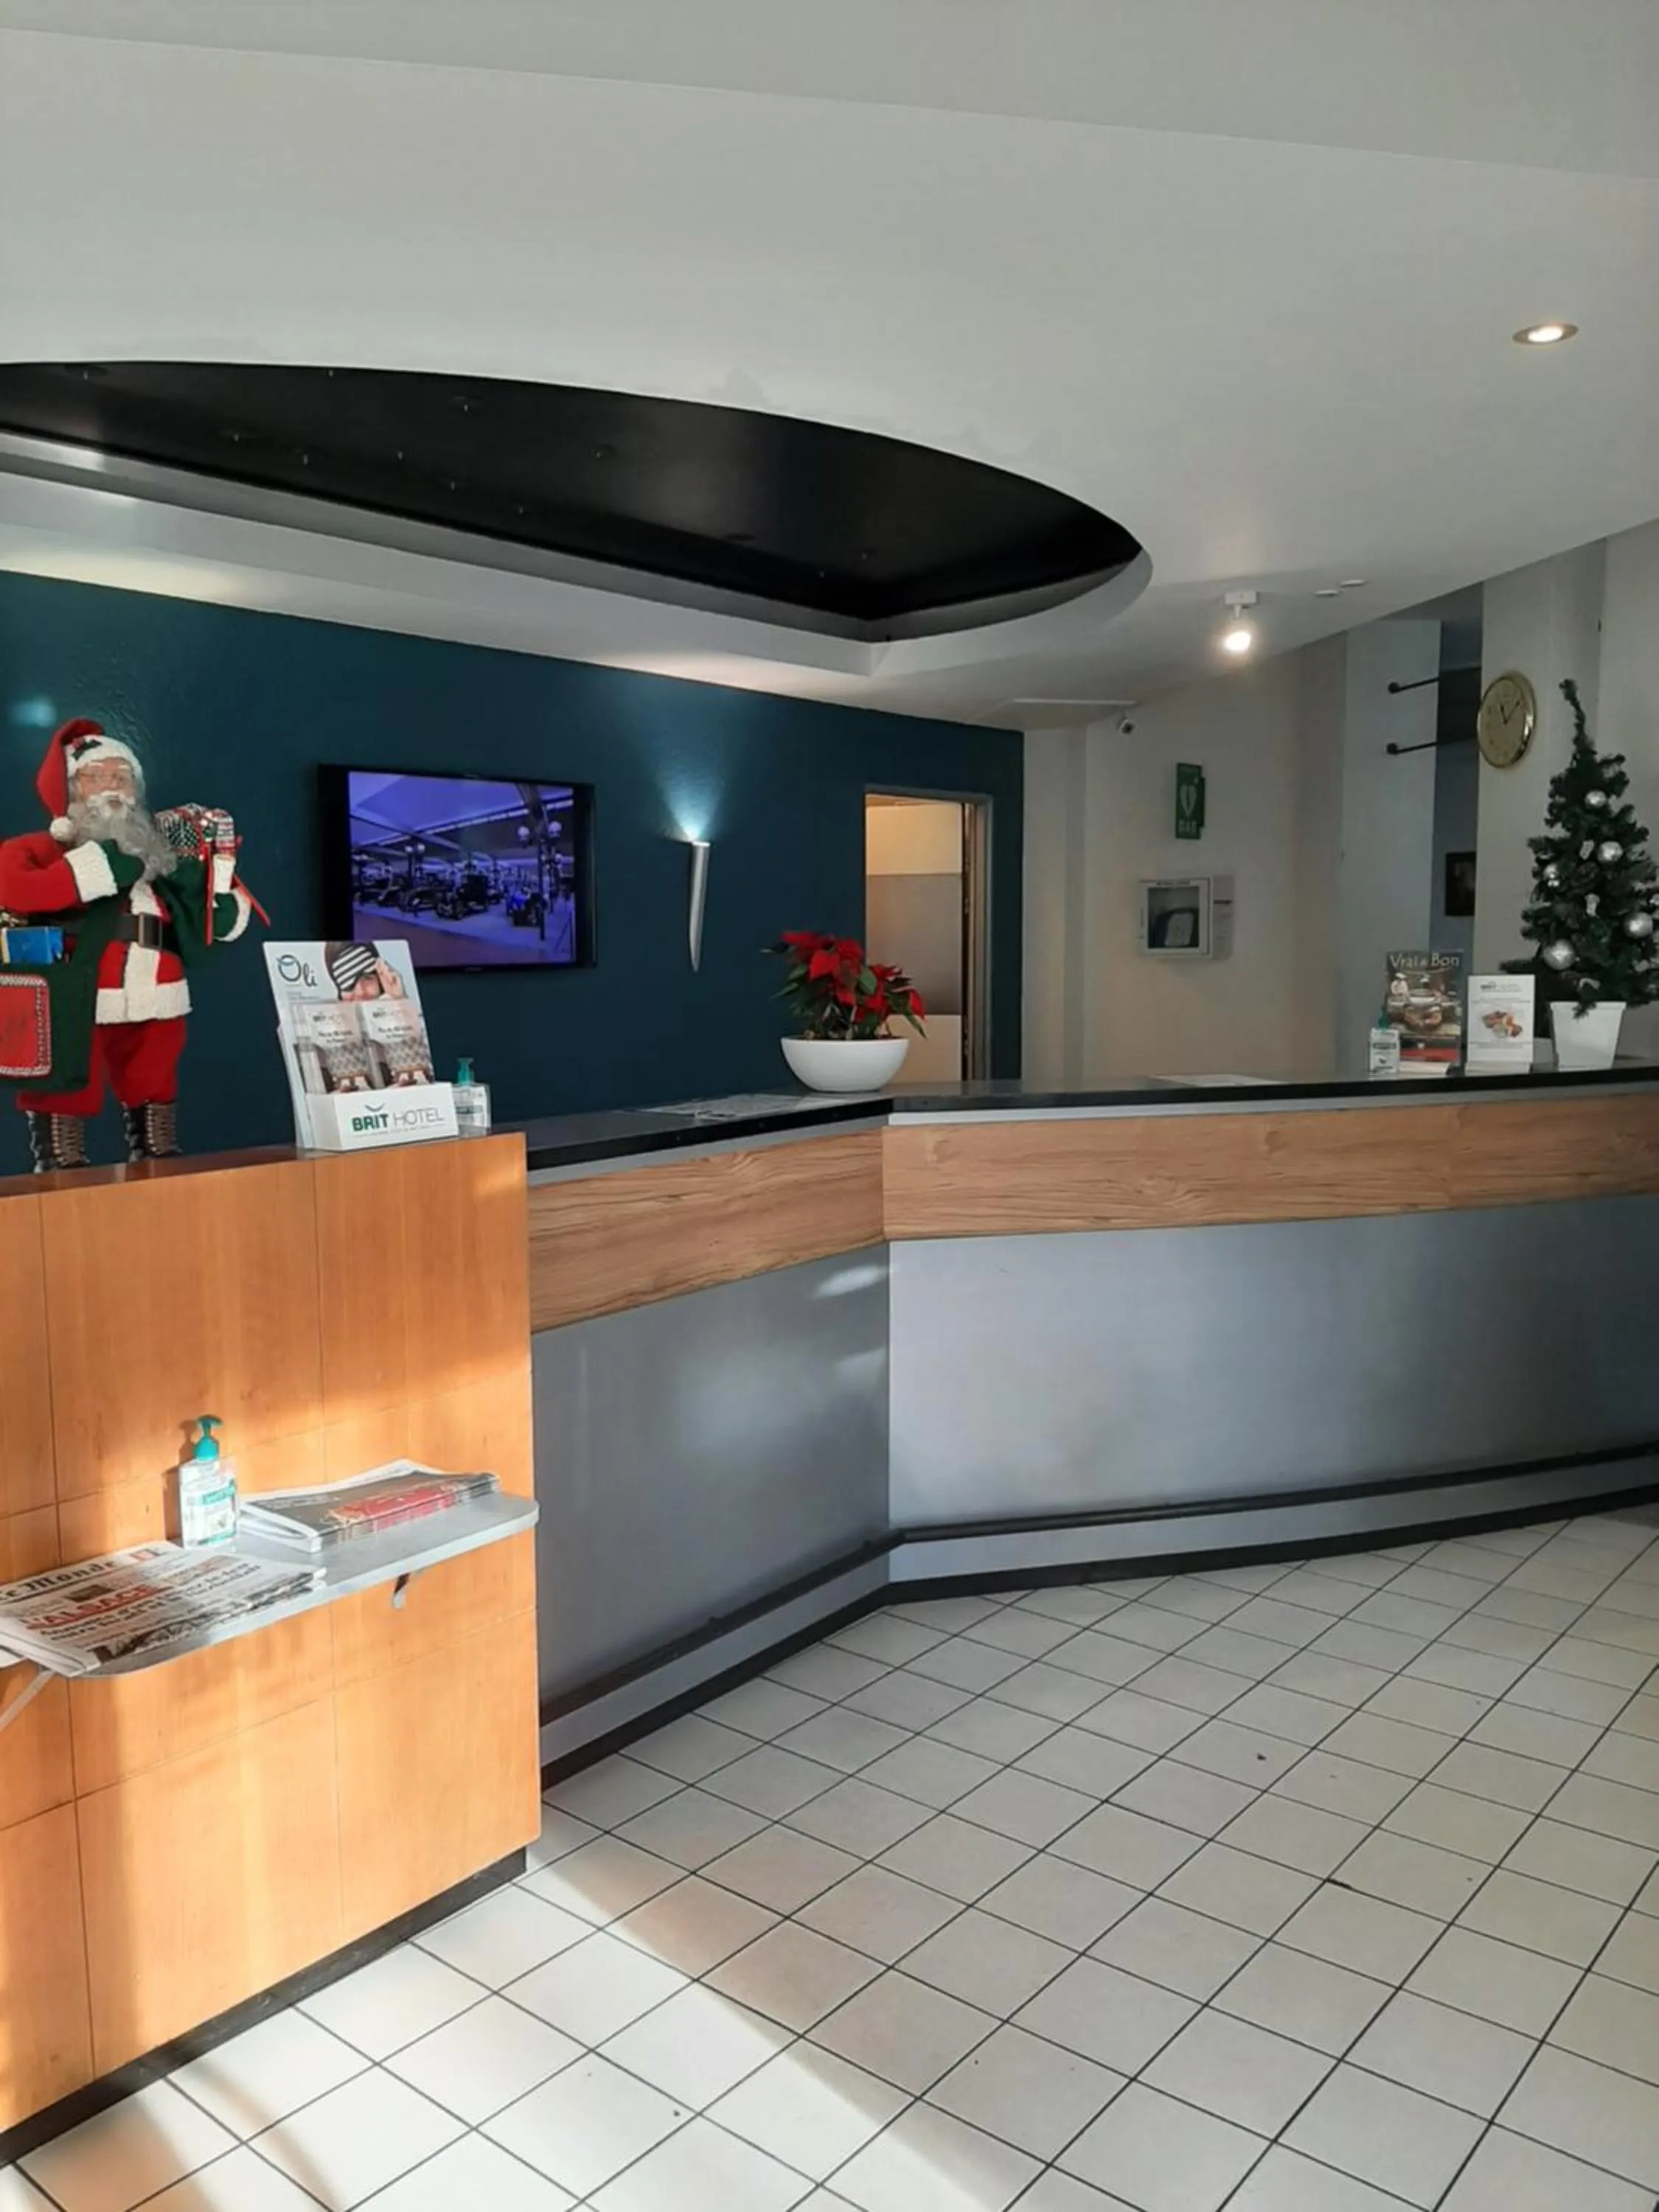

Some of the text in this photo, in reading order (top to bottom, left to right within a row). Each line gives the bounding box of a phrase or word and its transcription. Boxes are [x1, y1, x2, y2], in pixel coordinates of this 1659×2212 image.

[276, 954, 318, 987] Oli
[1431, 953, 1459, 967] Bon
[352, 1113, 389, 1132] BRIT
[392, 1107, 445, 1127] HOTEL
[16, 1561, 115, 1591] Monde
